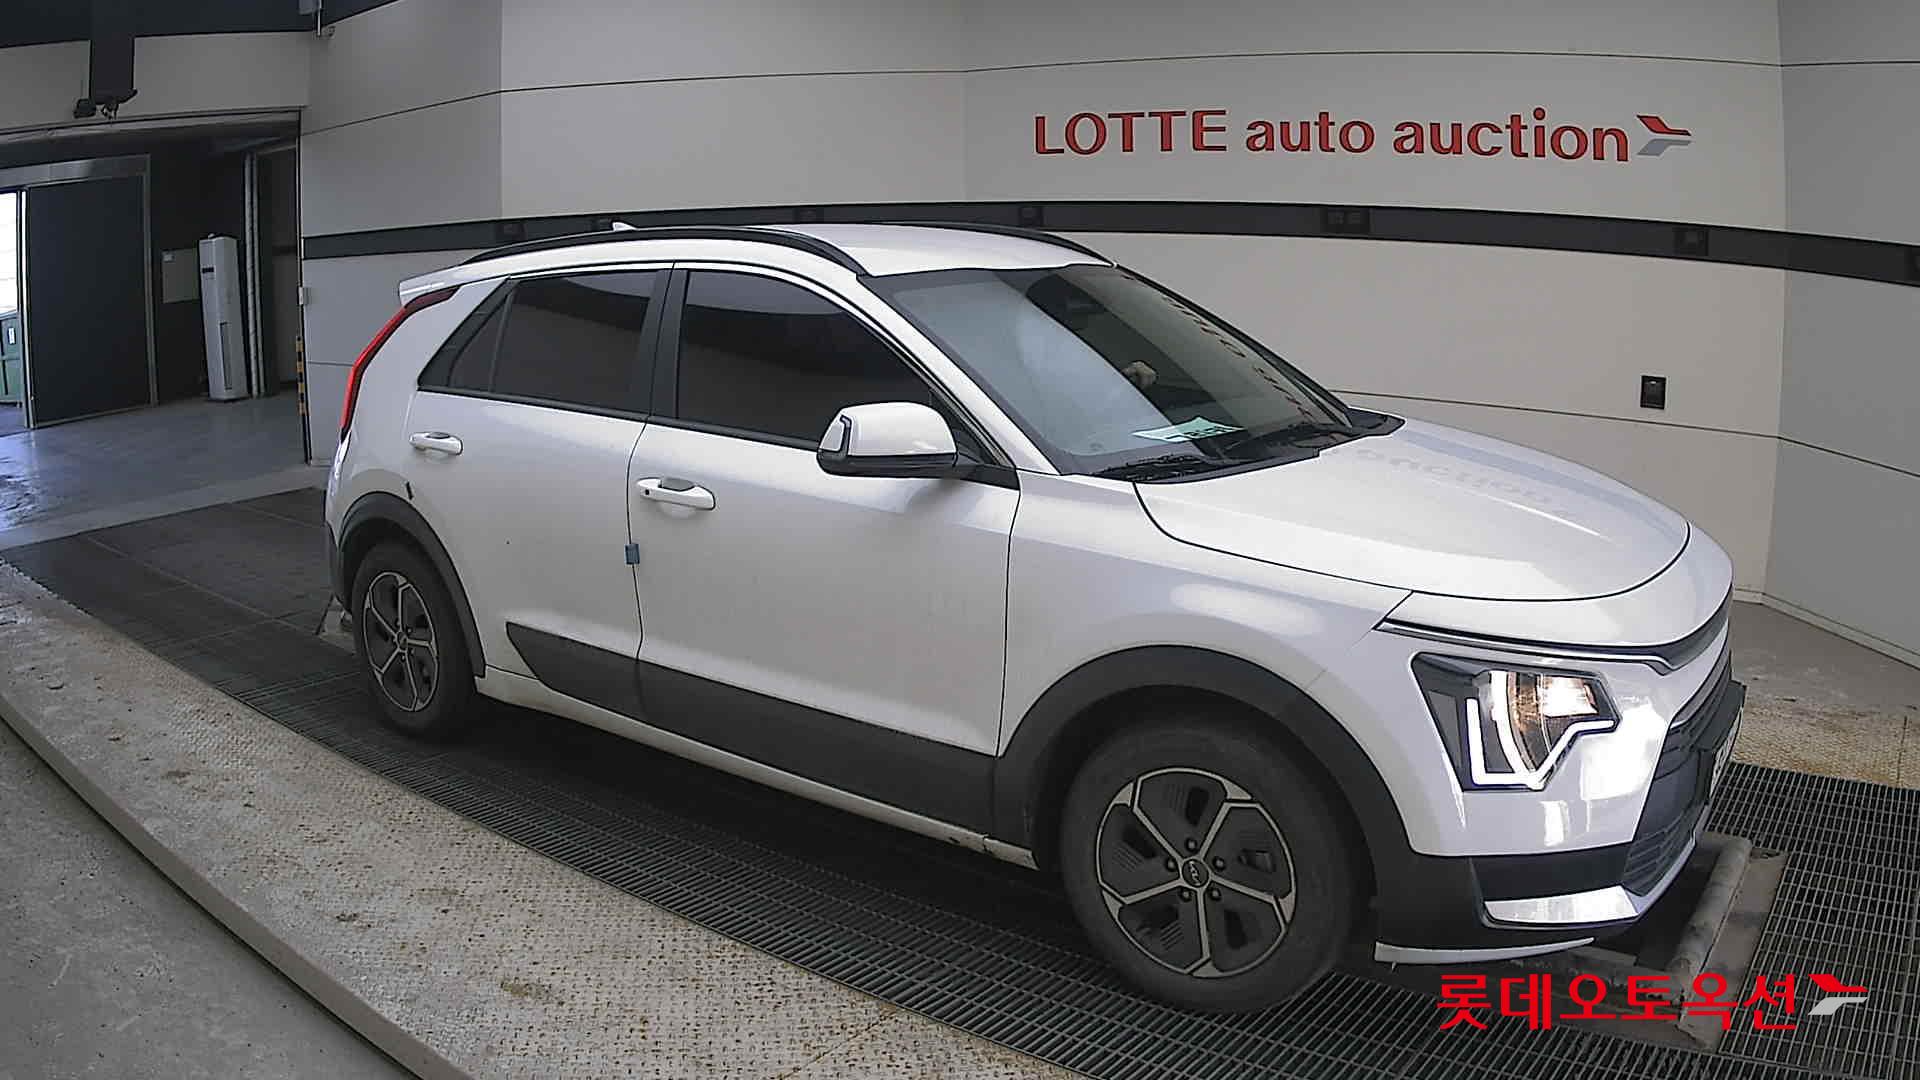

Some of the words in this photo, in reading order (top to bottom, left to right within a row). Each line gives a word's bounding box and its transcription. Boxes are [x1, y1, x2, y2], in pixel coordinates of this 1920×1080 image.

[1034, 109, 1228, 155] LOTTE
[1245, 110, 1376, 154] auto
[1392, 106, 1630, 162] auction
